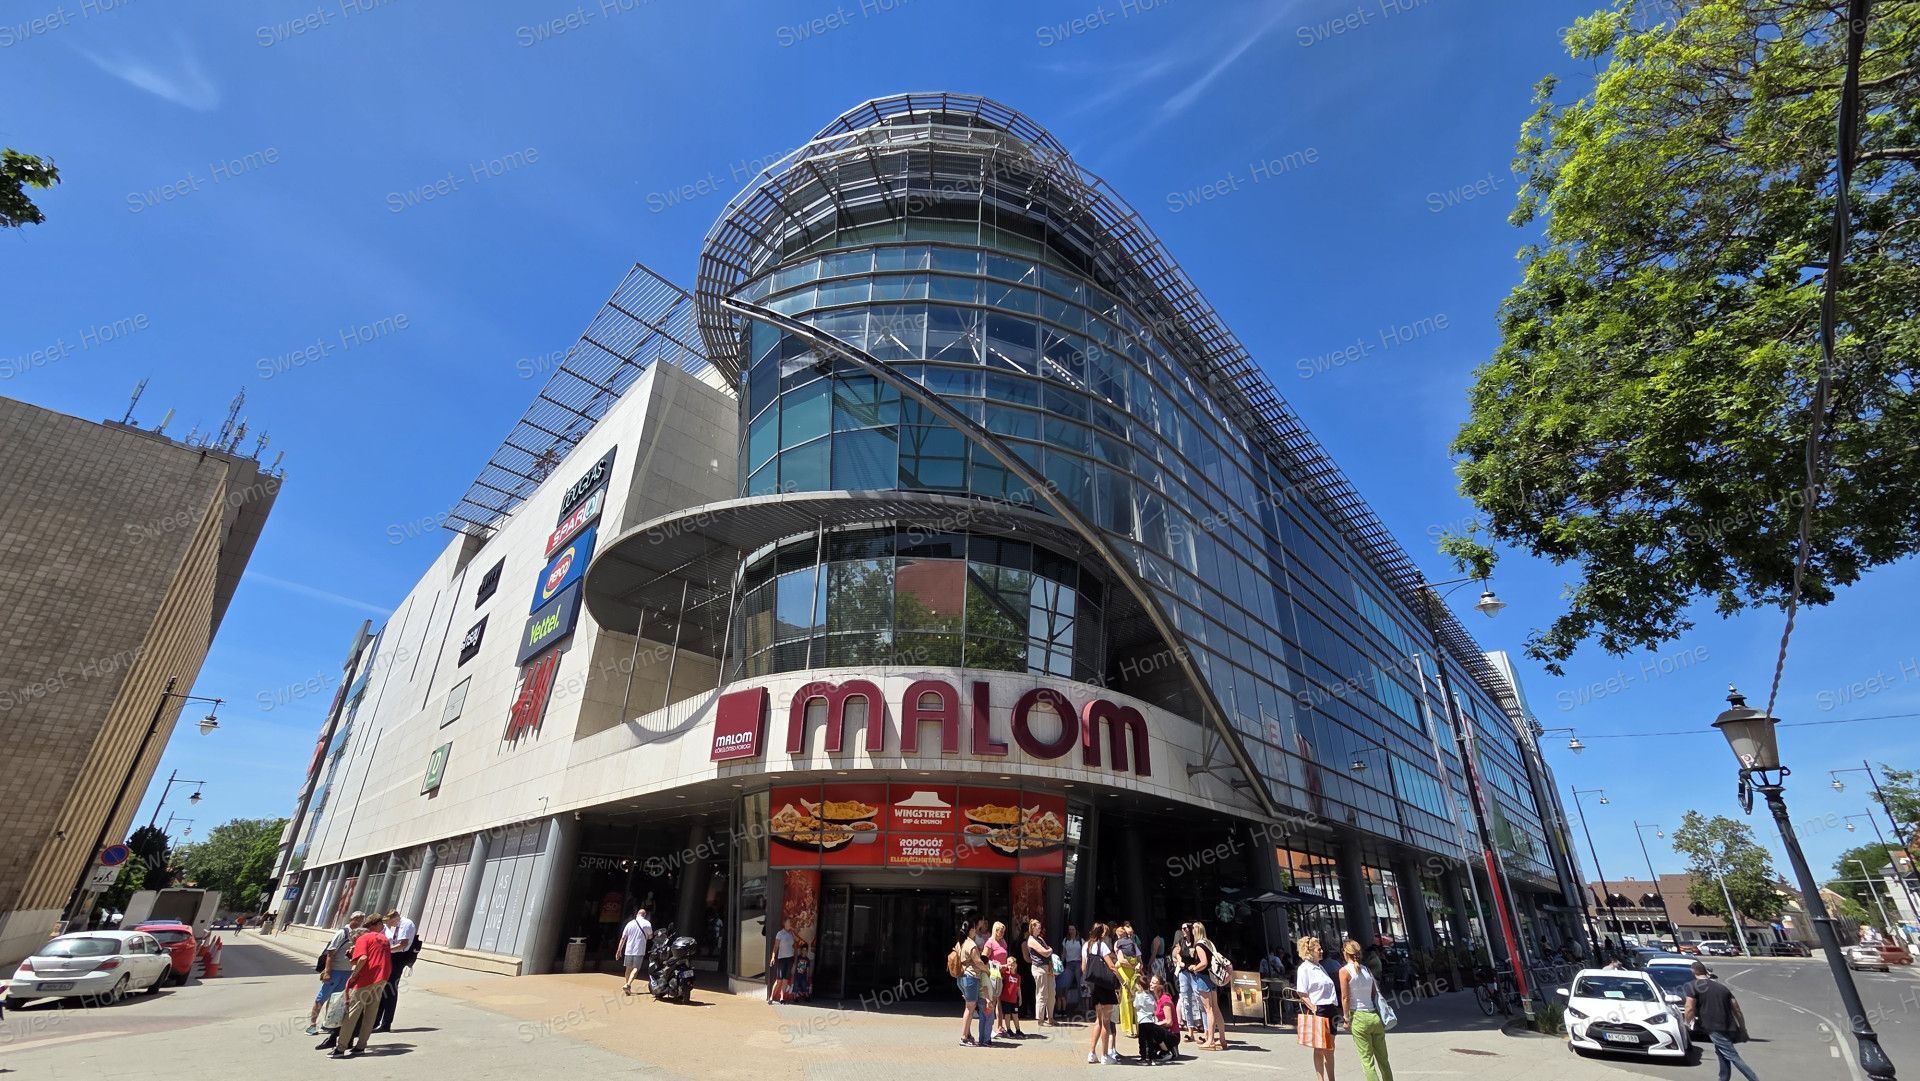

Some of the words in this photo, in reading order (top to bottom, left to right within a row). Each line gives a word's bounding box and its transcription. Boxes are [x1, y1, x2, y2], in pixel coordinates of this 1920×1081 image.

[551, 507, 585, 546] SPAR
[548, 560, 571, 583] PEPCO
[785, 679, 1151, 777] MALOM
[716, 731, 752, 747] MALOM
[894, 808, 952, 819] WINGSTREET
[902, 847, 941, 856] SZAFTOS
[498, 874, 510, 889] AS
[491, 893, 507, 910] YOU
[485, 912, 503, 930] LIVE
